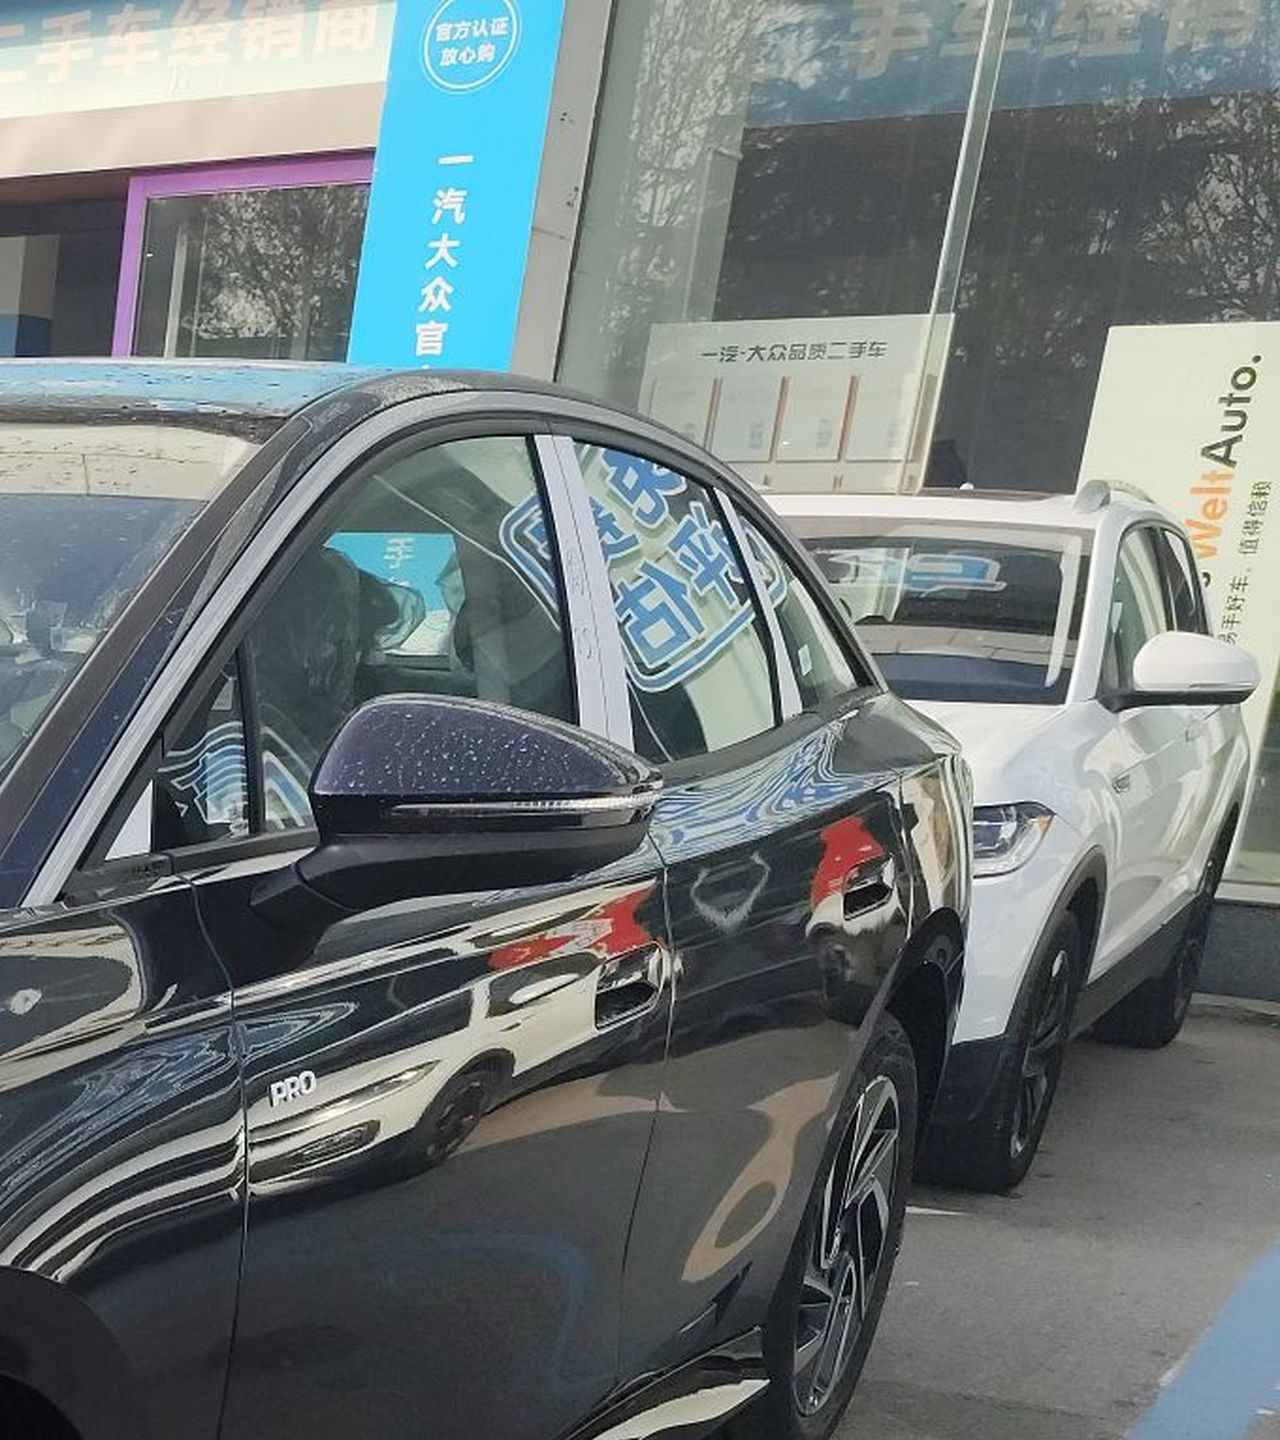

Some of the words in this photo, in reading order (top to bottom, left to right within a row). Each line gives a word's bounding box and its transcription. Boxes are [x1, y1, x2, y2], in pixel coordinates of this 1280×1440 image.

[435, 16, 510, 42] 官方认证
[440, 44, 496, 67] 放心购
[415, 154, 474, 362] 一汽大众官
[268, 1070, 317, 1107] PRO
